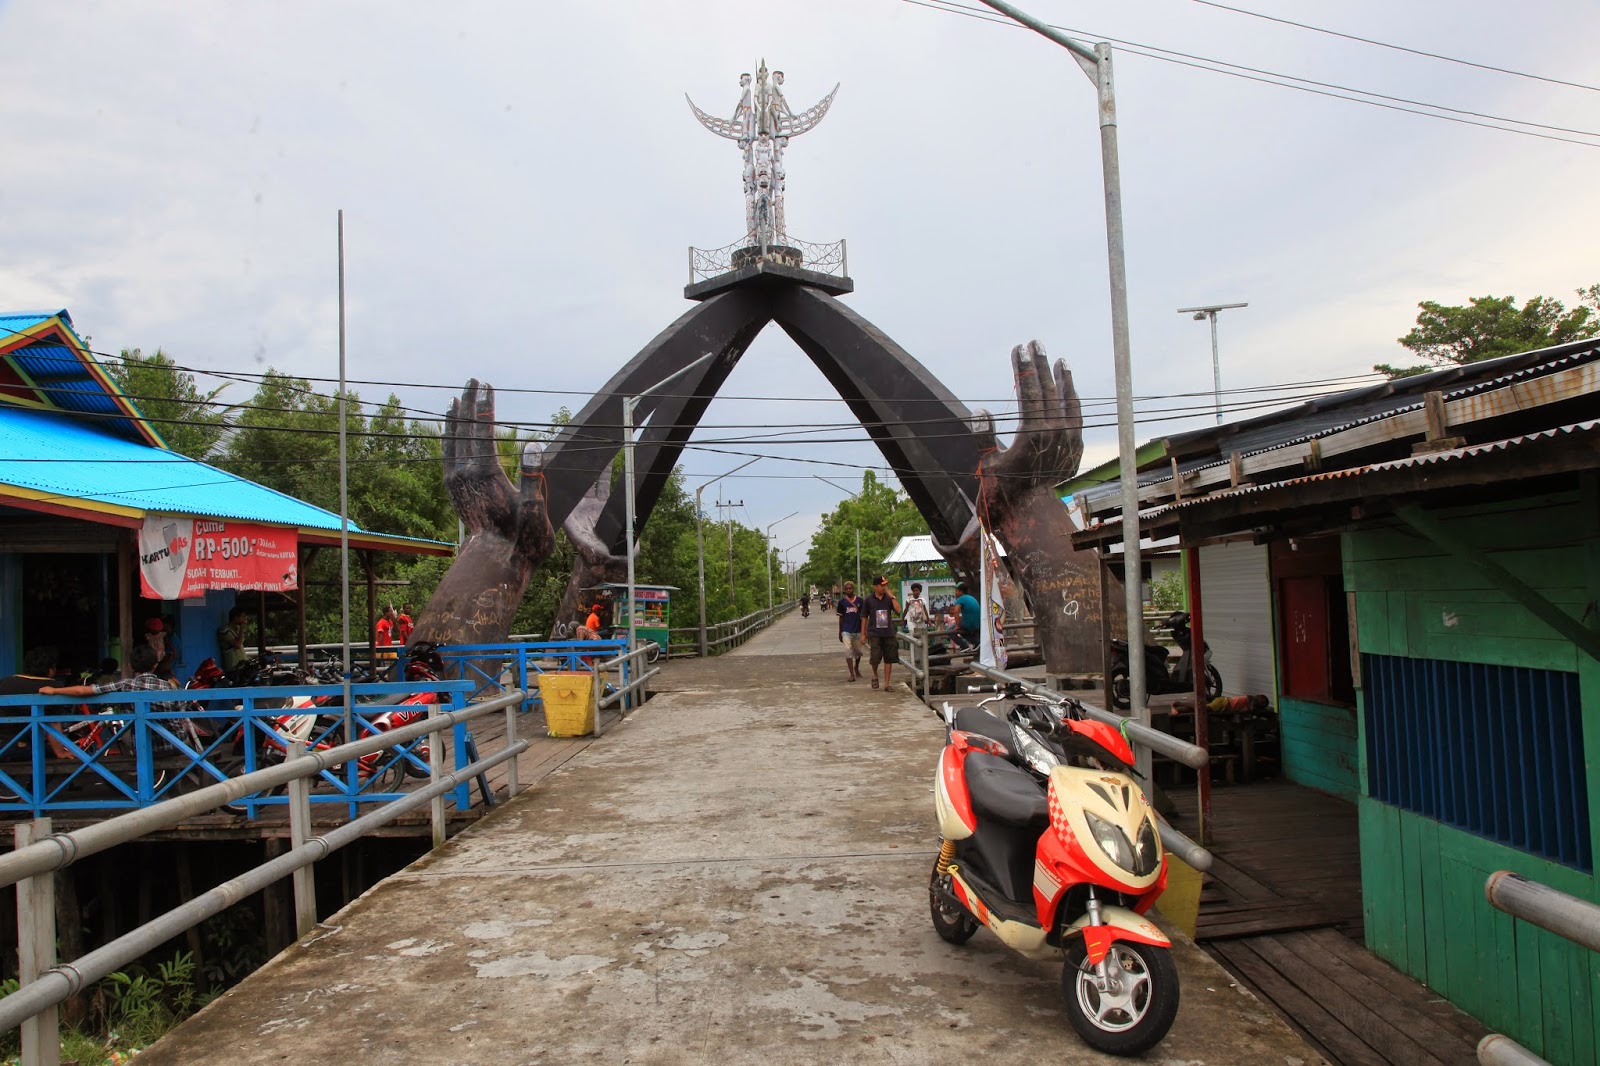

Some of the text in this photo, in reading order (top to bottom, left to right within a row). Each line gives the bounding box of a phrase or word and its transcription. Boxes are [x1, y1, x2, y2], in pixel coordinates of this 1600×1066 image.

[196, 521, 225, 536] Cuma
[141, 547, 171, 565] KARTU
[187, 567, 207, 579] SUDAH
